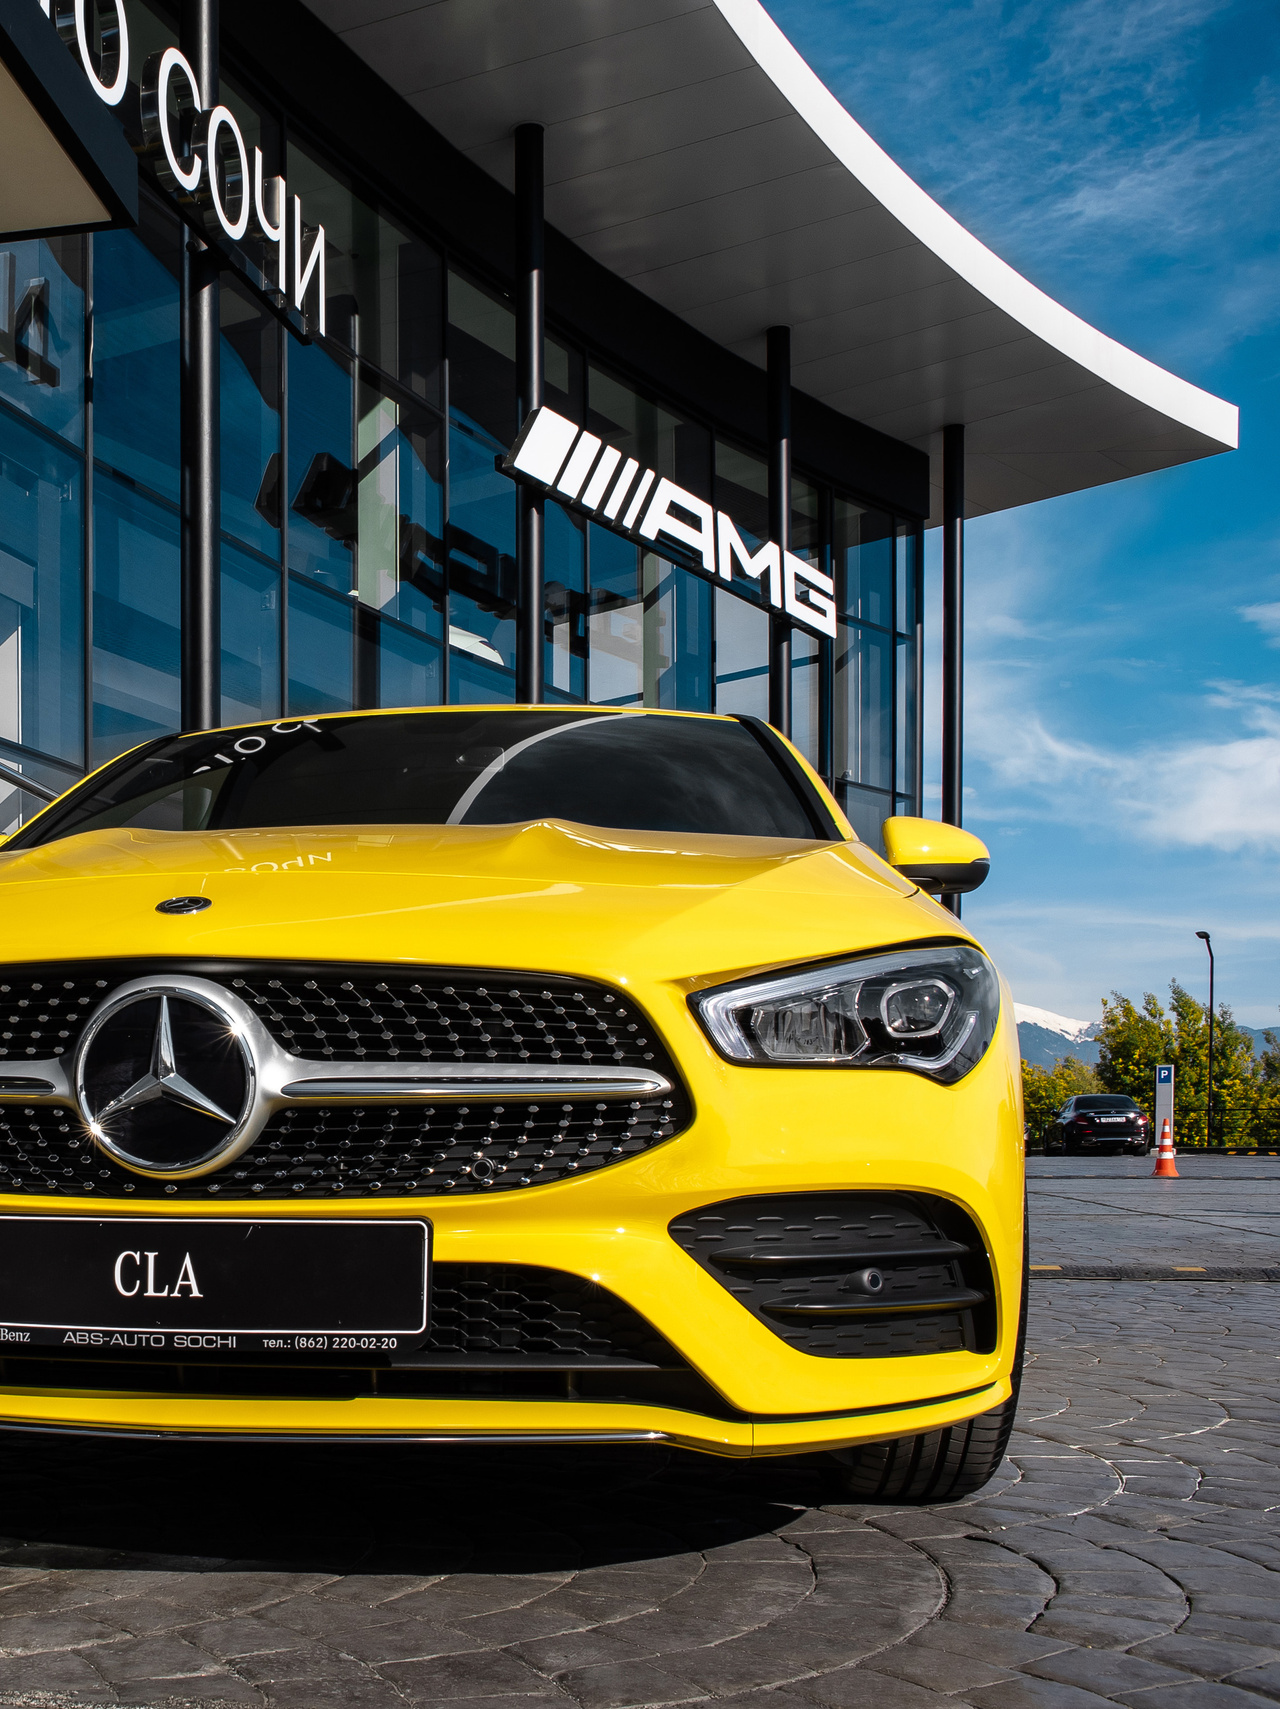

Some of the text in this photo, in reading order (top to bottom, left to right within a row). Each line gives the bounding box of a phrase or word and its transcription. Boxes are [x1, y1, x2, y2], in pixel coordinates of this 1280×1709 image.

[638, 476, 838, 640] AMG
[1161, 1070, 1169, 1079] P
[114, 1250, 204, 1298] CLA
[62, 1331, 237, 1349] ABS-AUTO SOCHI
[262, 1335, 398, 1350] тел.: (862) 220-02-20
